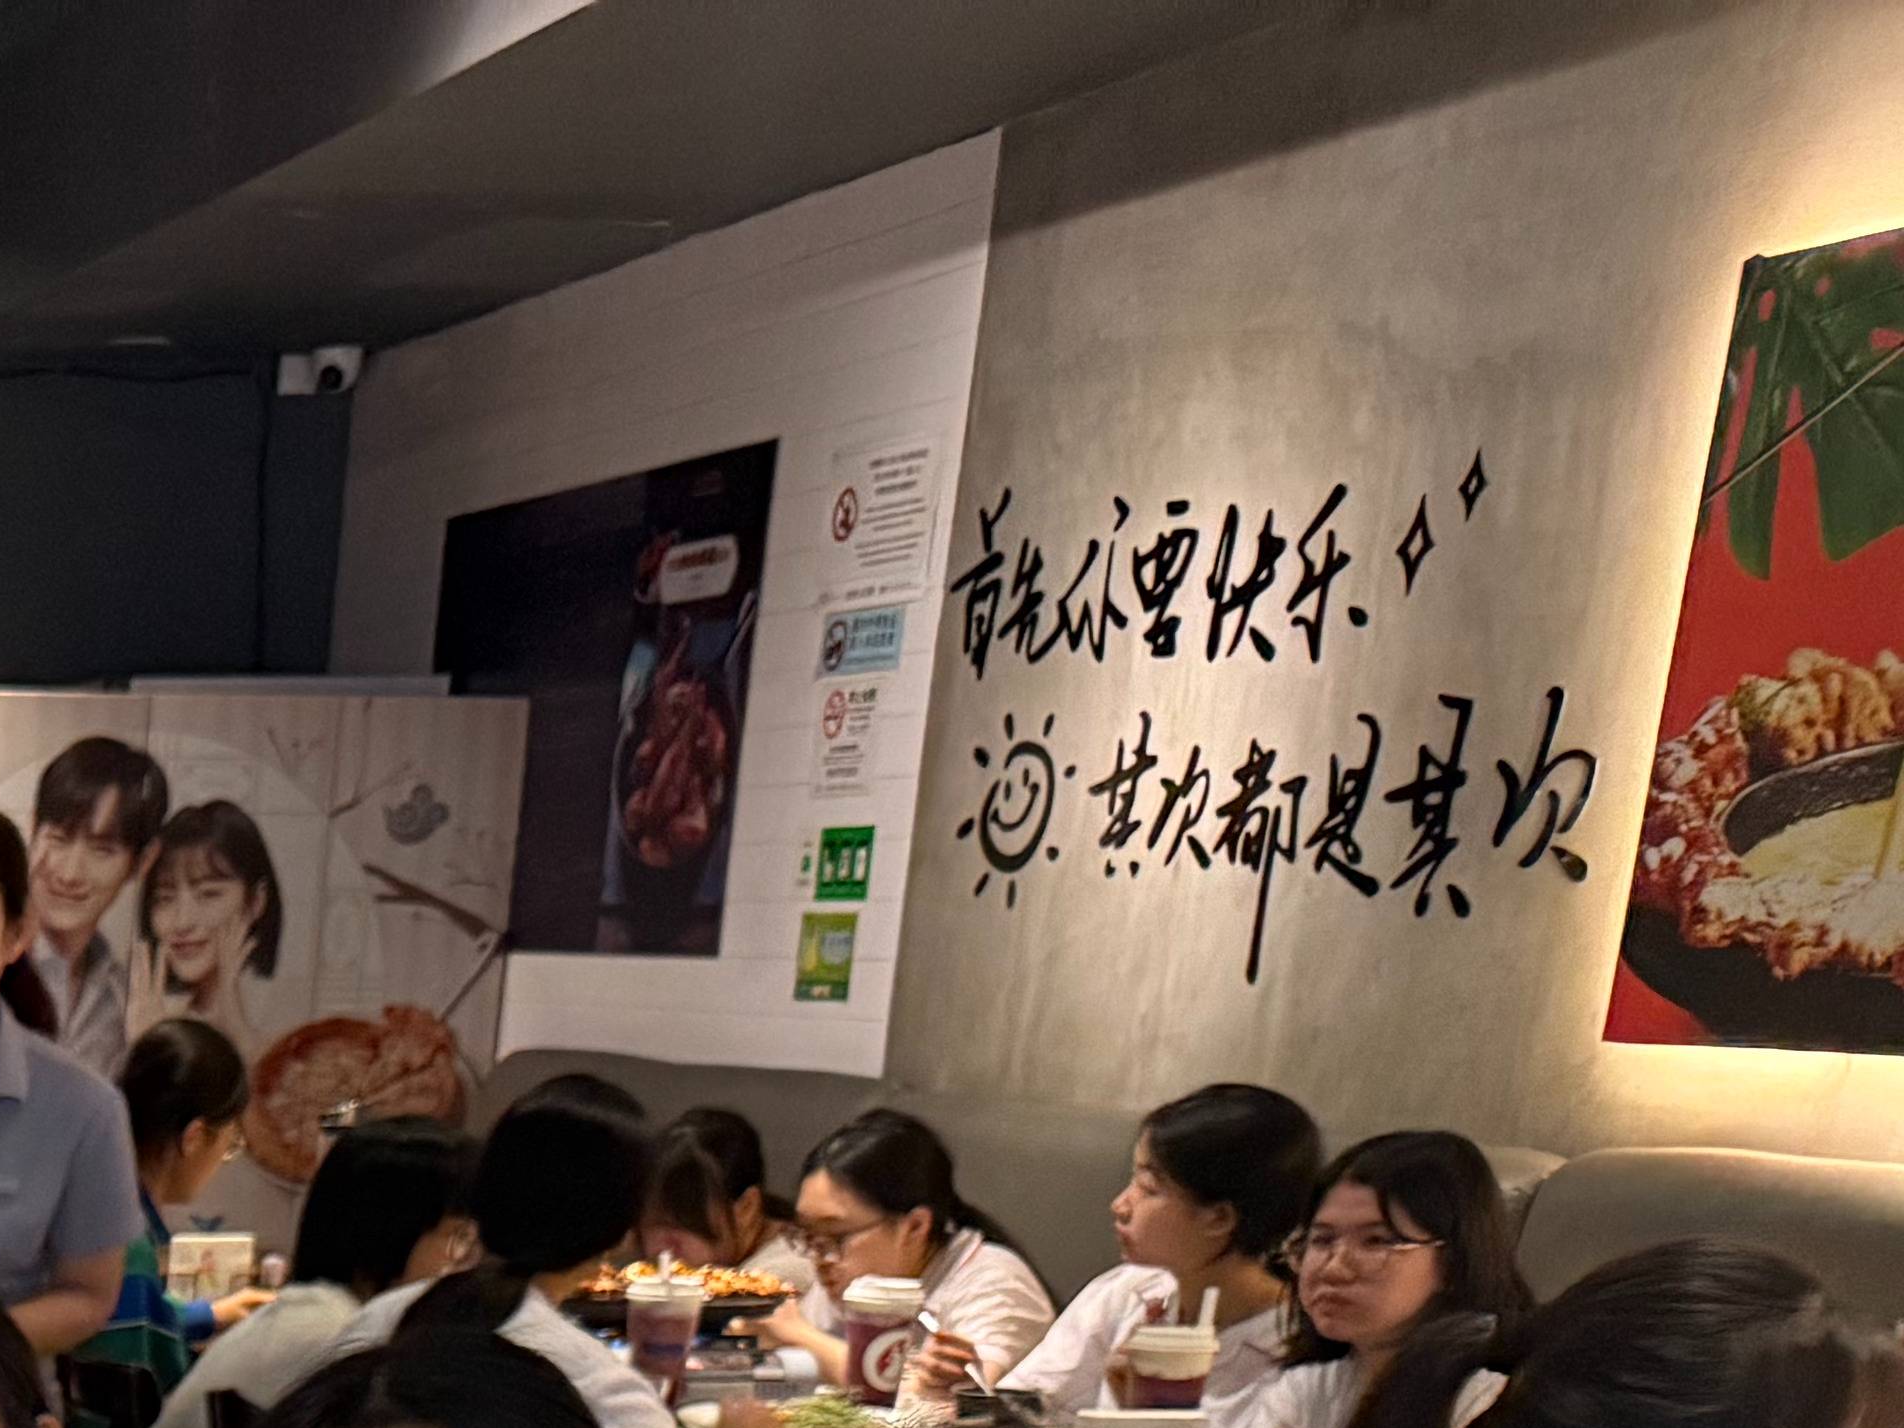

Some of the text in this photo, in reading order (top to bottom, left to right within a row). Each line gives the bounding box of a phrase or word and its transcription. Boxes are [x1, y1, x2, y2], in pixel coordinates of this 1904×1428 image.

[1090, 687, 1597, 983] 其次都是其次
